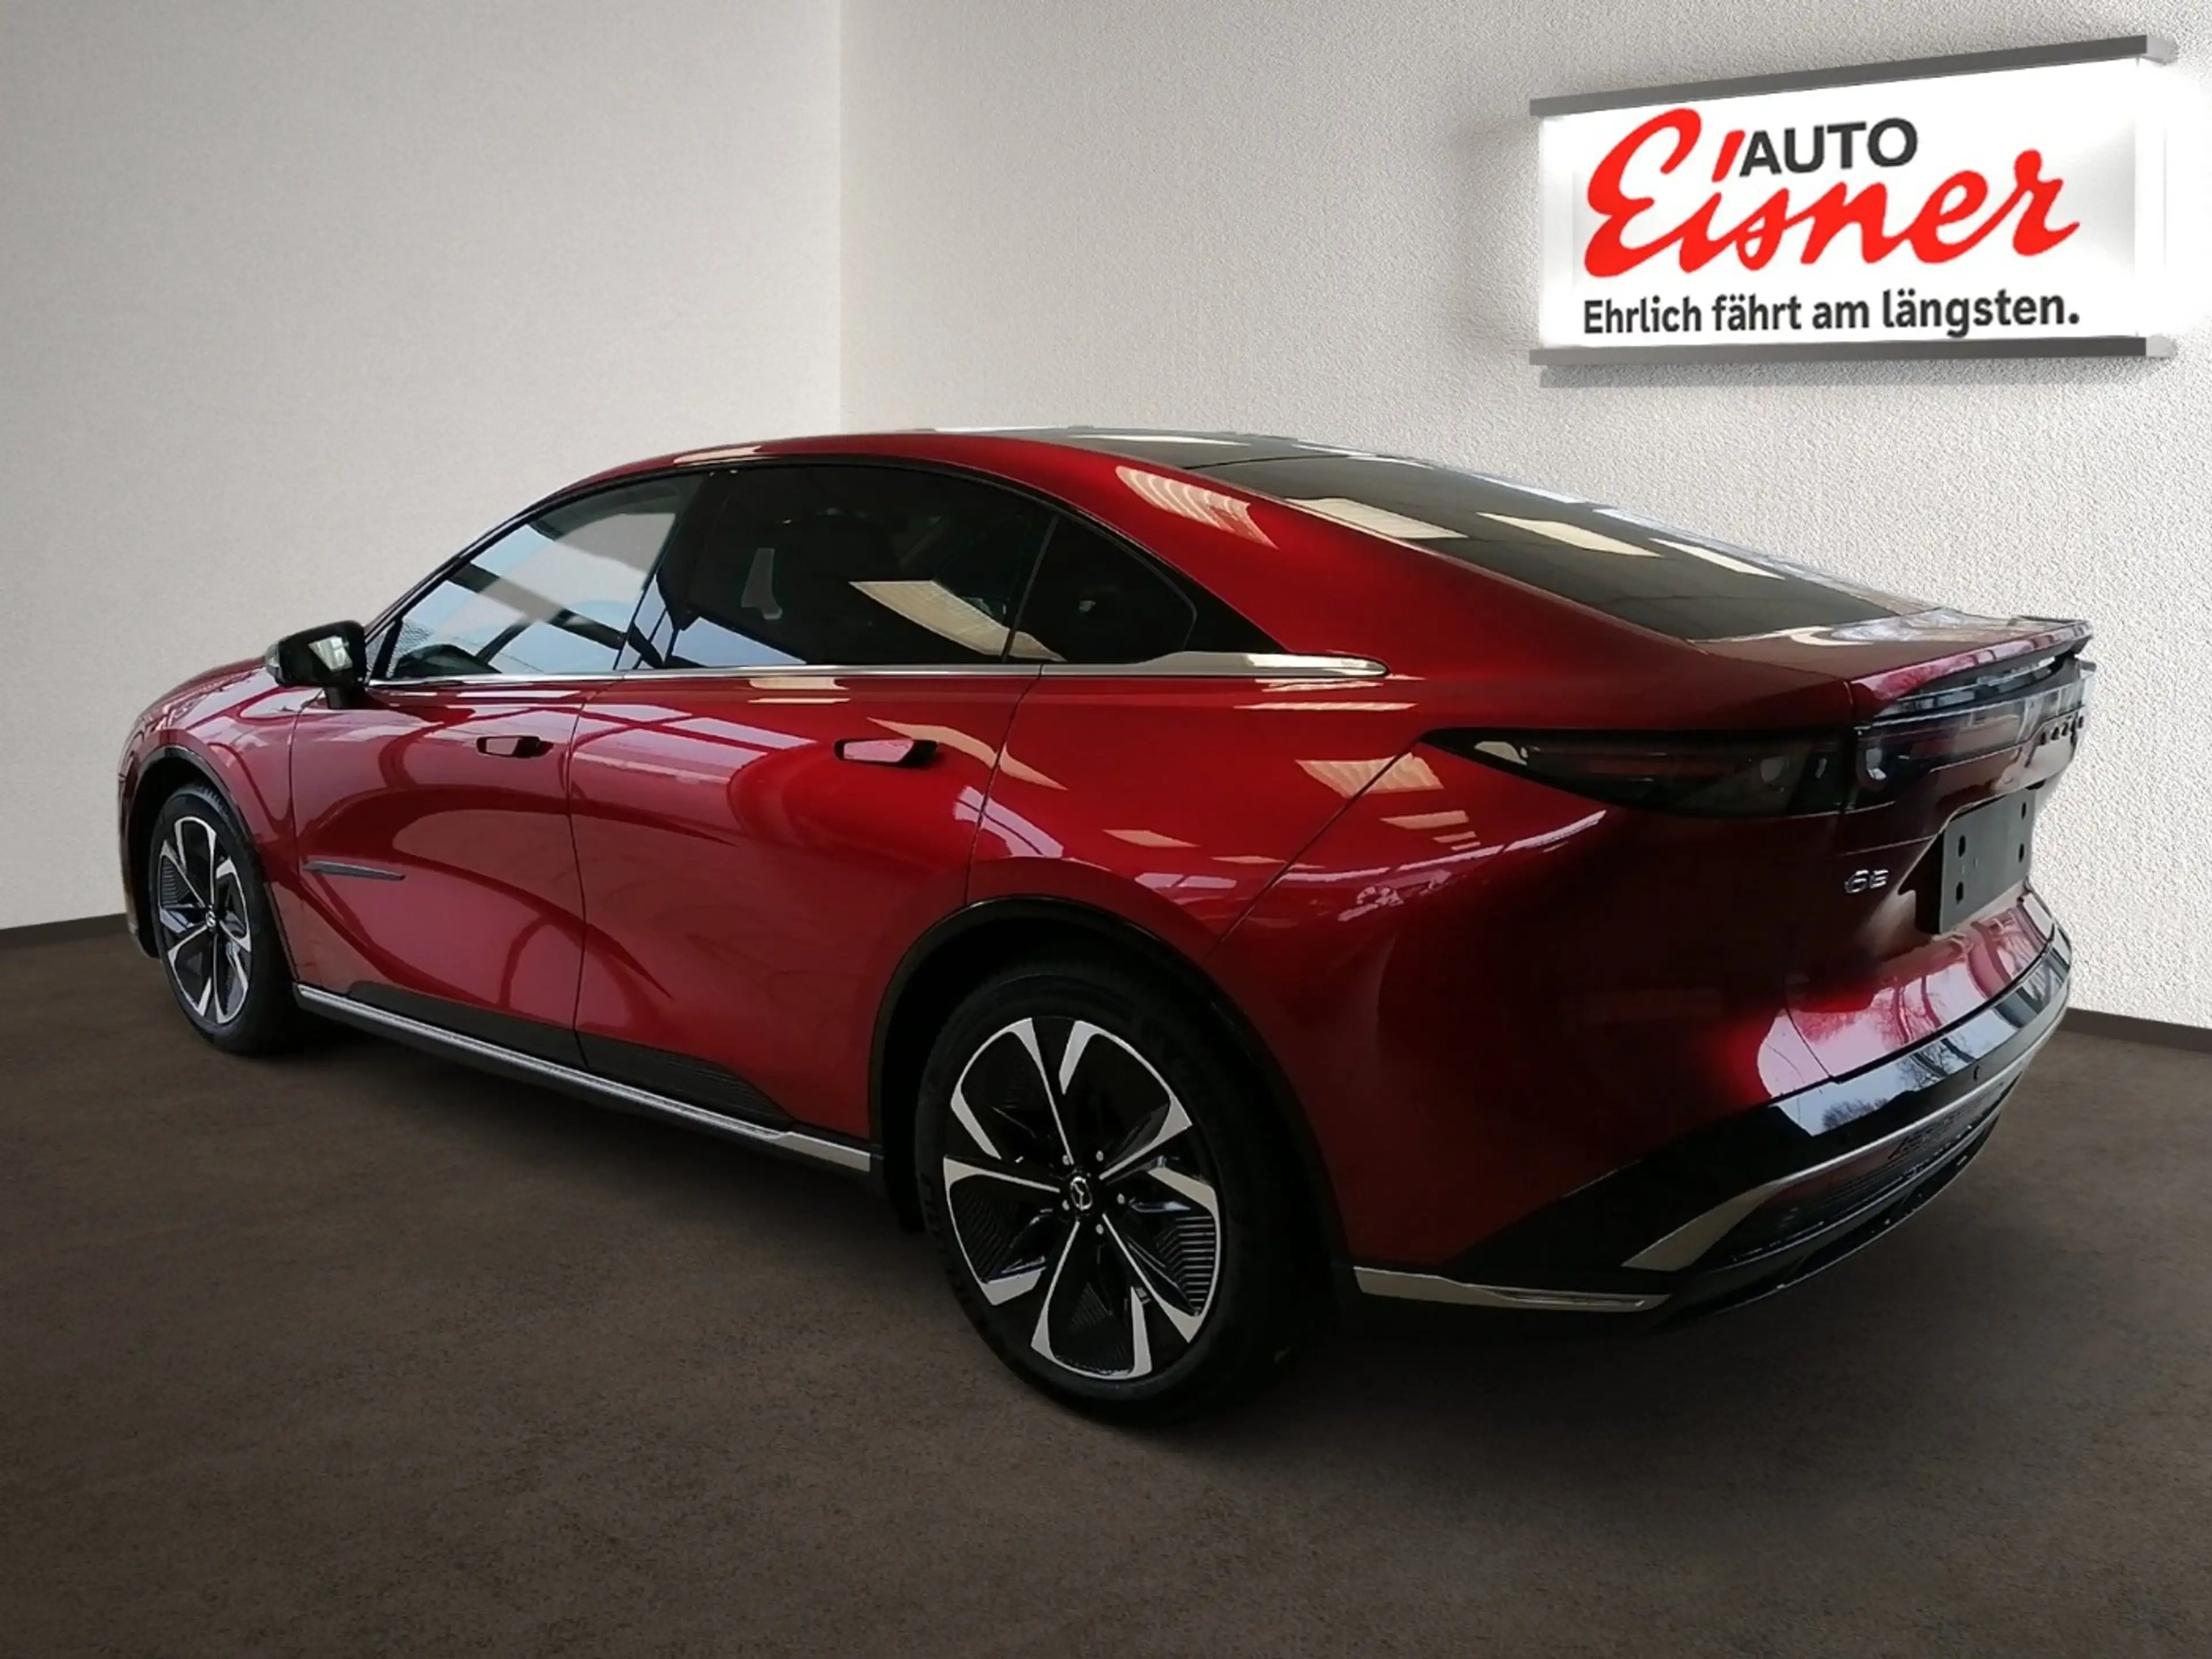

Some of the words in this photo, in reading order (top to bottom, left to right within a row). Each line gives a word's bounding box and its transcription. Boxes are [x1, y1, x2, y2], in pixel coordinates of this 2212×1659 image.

[1739, 118, 1918, 177] AUTO
[1584, 108, 2079, 278] Eisner
[1585, 296, 1701, 334] Ehrlich
[1711, 294, 1802, 331] fährt
[1812, 301, 1869, 329] am
[1883, 289, 2080, 339] längsten.
